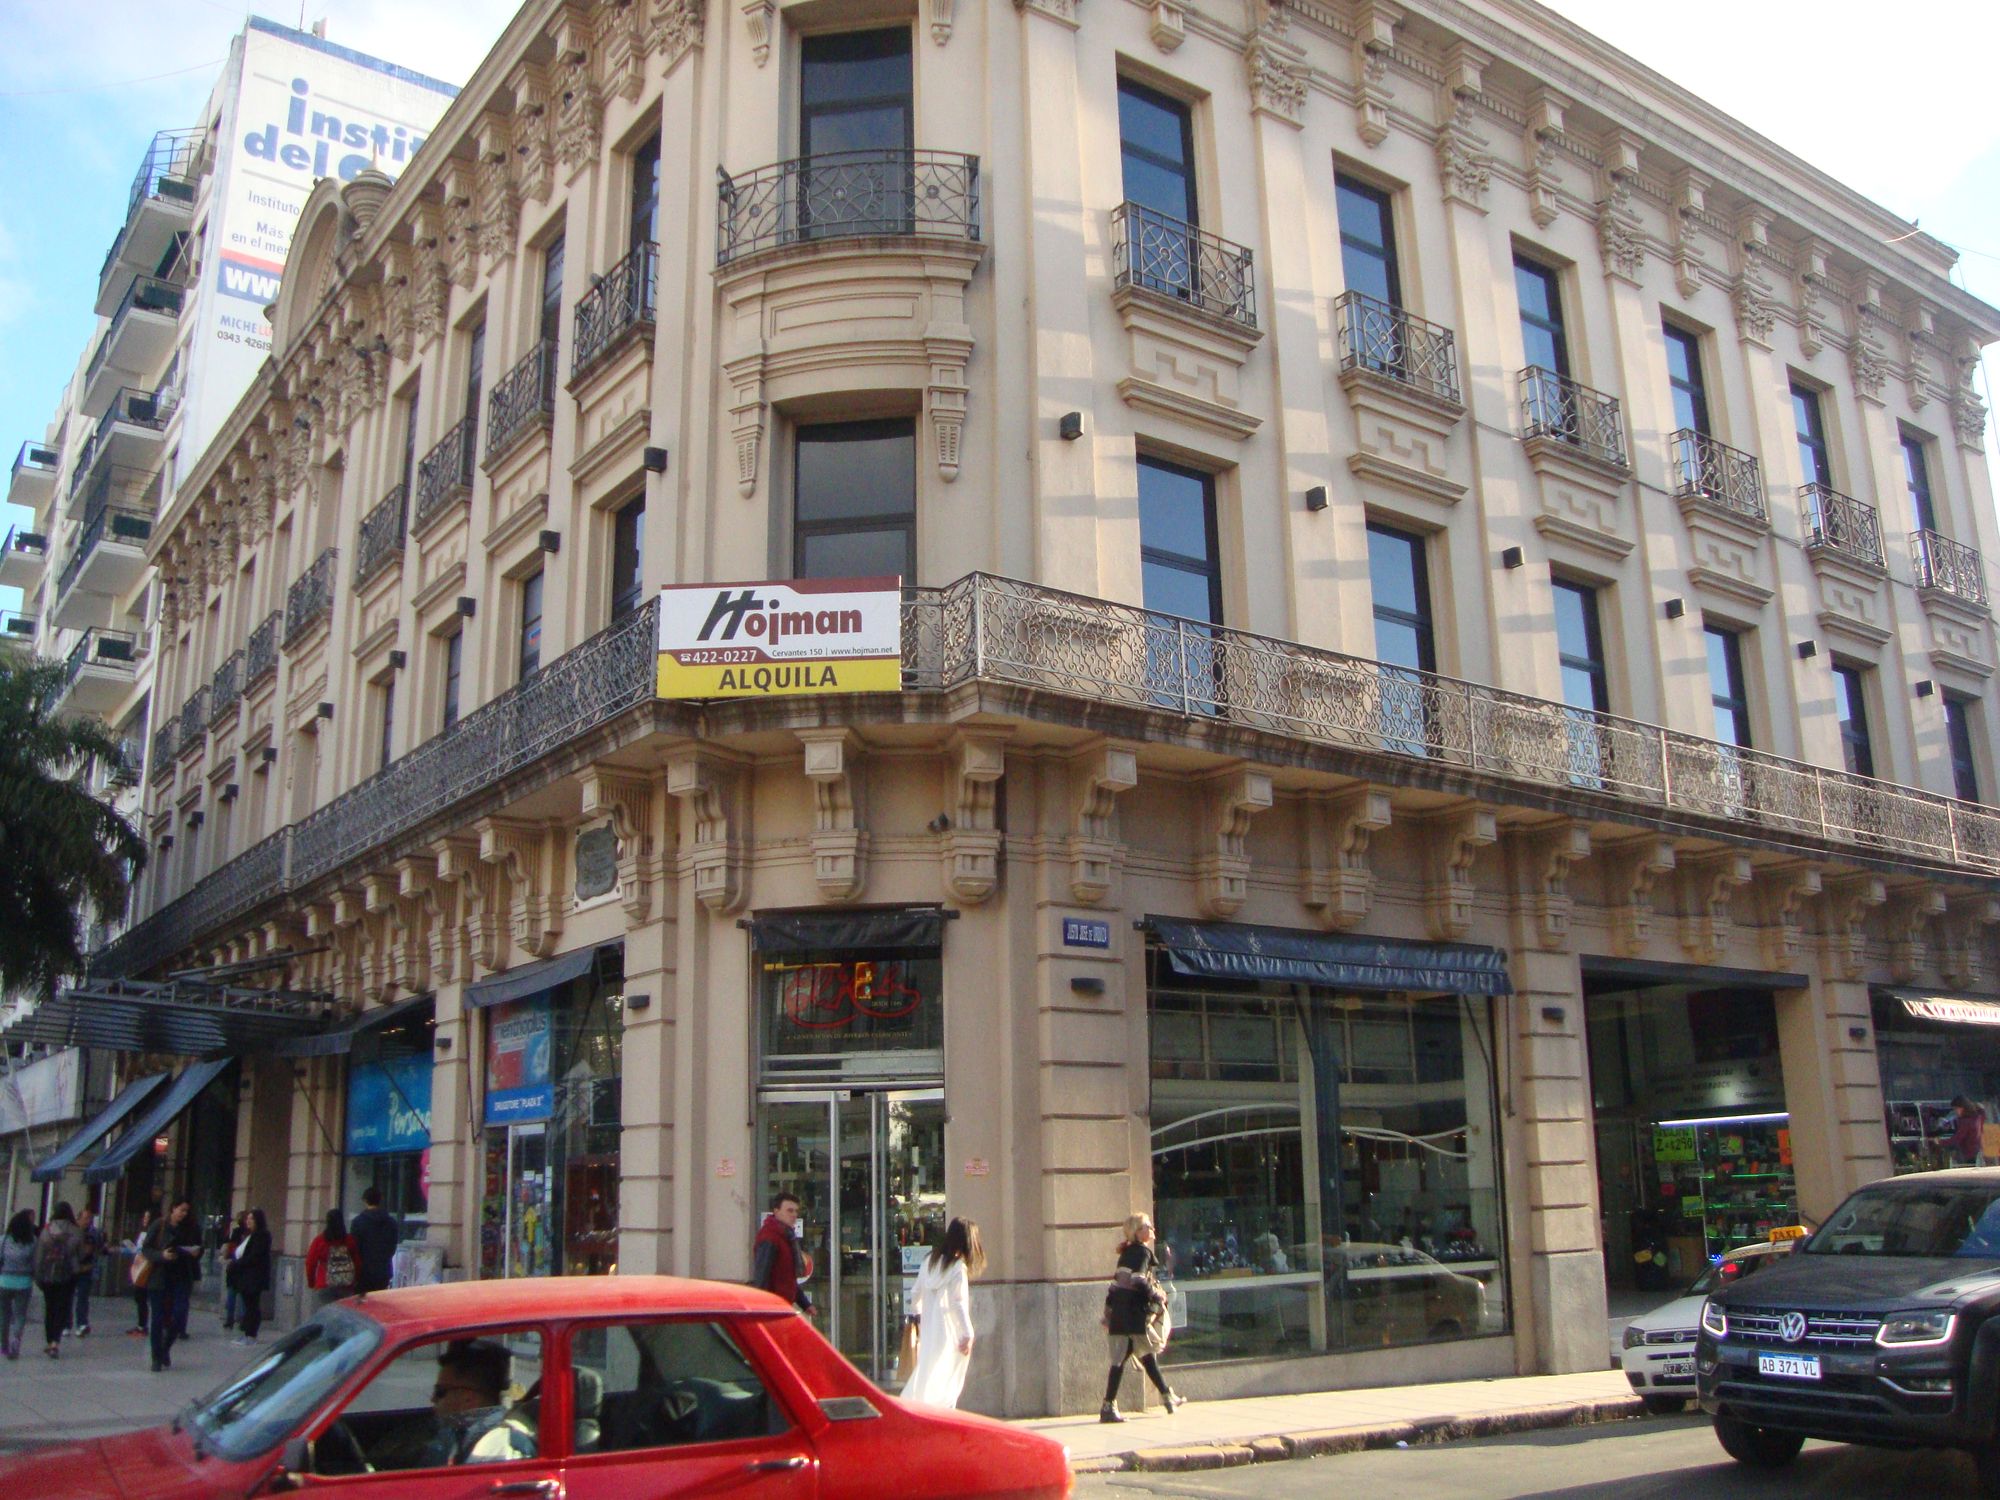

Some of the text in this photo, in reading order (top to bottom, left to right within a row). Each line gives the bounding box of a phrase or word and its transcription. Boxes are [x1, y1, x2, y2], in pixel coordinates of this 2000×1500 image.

[244, 123, 330, 178] del
[248, 190, 301, 216] Instituto
[231, 233, 247, 244] en
[250, 236, 262, 248] el
[217, 330, 241, 344] 0343
[696, 590, 863, 645] Hojman
[692, 650, 757, 664] 422-0227
[771, 646, 893, 658] Cervantes 150 www.hojman.net
[718, 665, 838, 692] ALQUILA
[1762, 1359, 1816, 1376] AB 371 YL
